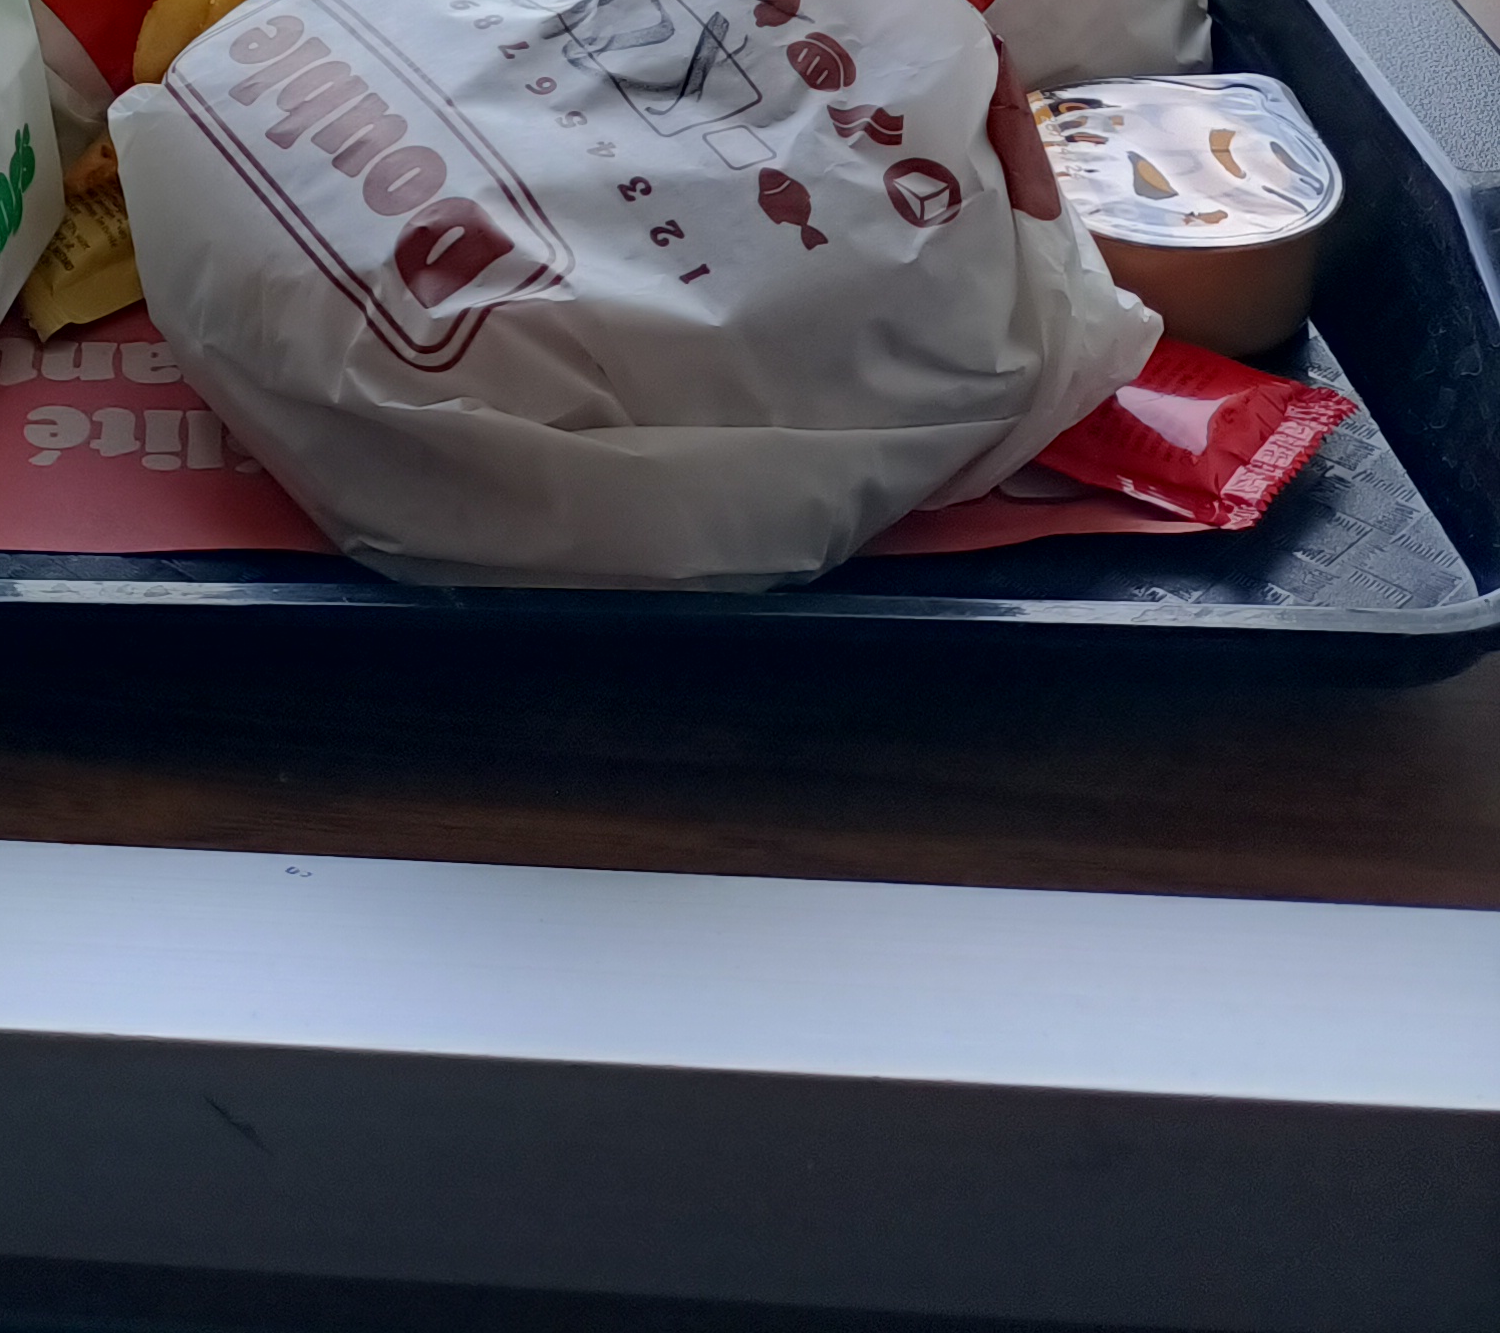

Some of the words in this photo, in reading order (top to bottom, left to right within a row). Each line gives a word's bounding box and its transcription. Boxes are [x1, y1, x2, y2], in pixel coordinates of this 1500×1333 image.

[497, 40, 530, 60] 7
[229, 14, 516, 310] Double
[618, 176, 652, 202] 3
[650, 219, 686, 247] 2
[679, 263, 711, 284] 1
[23, 404, 263, 473] lité
